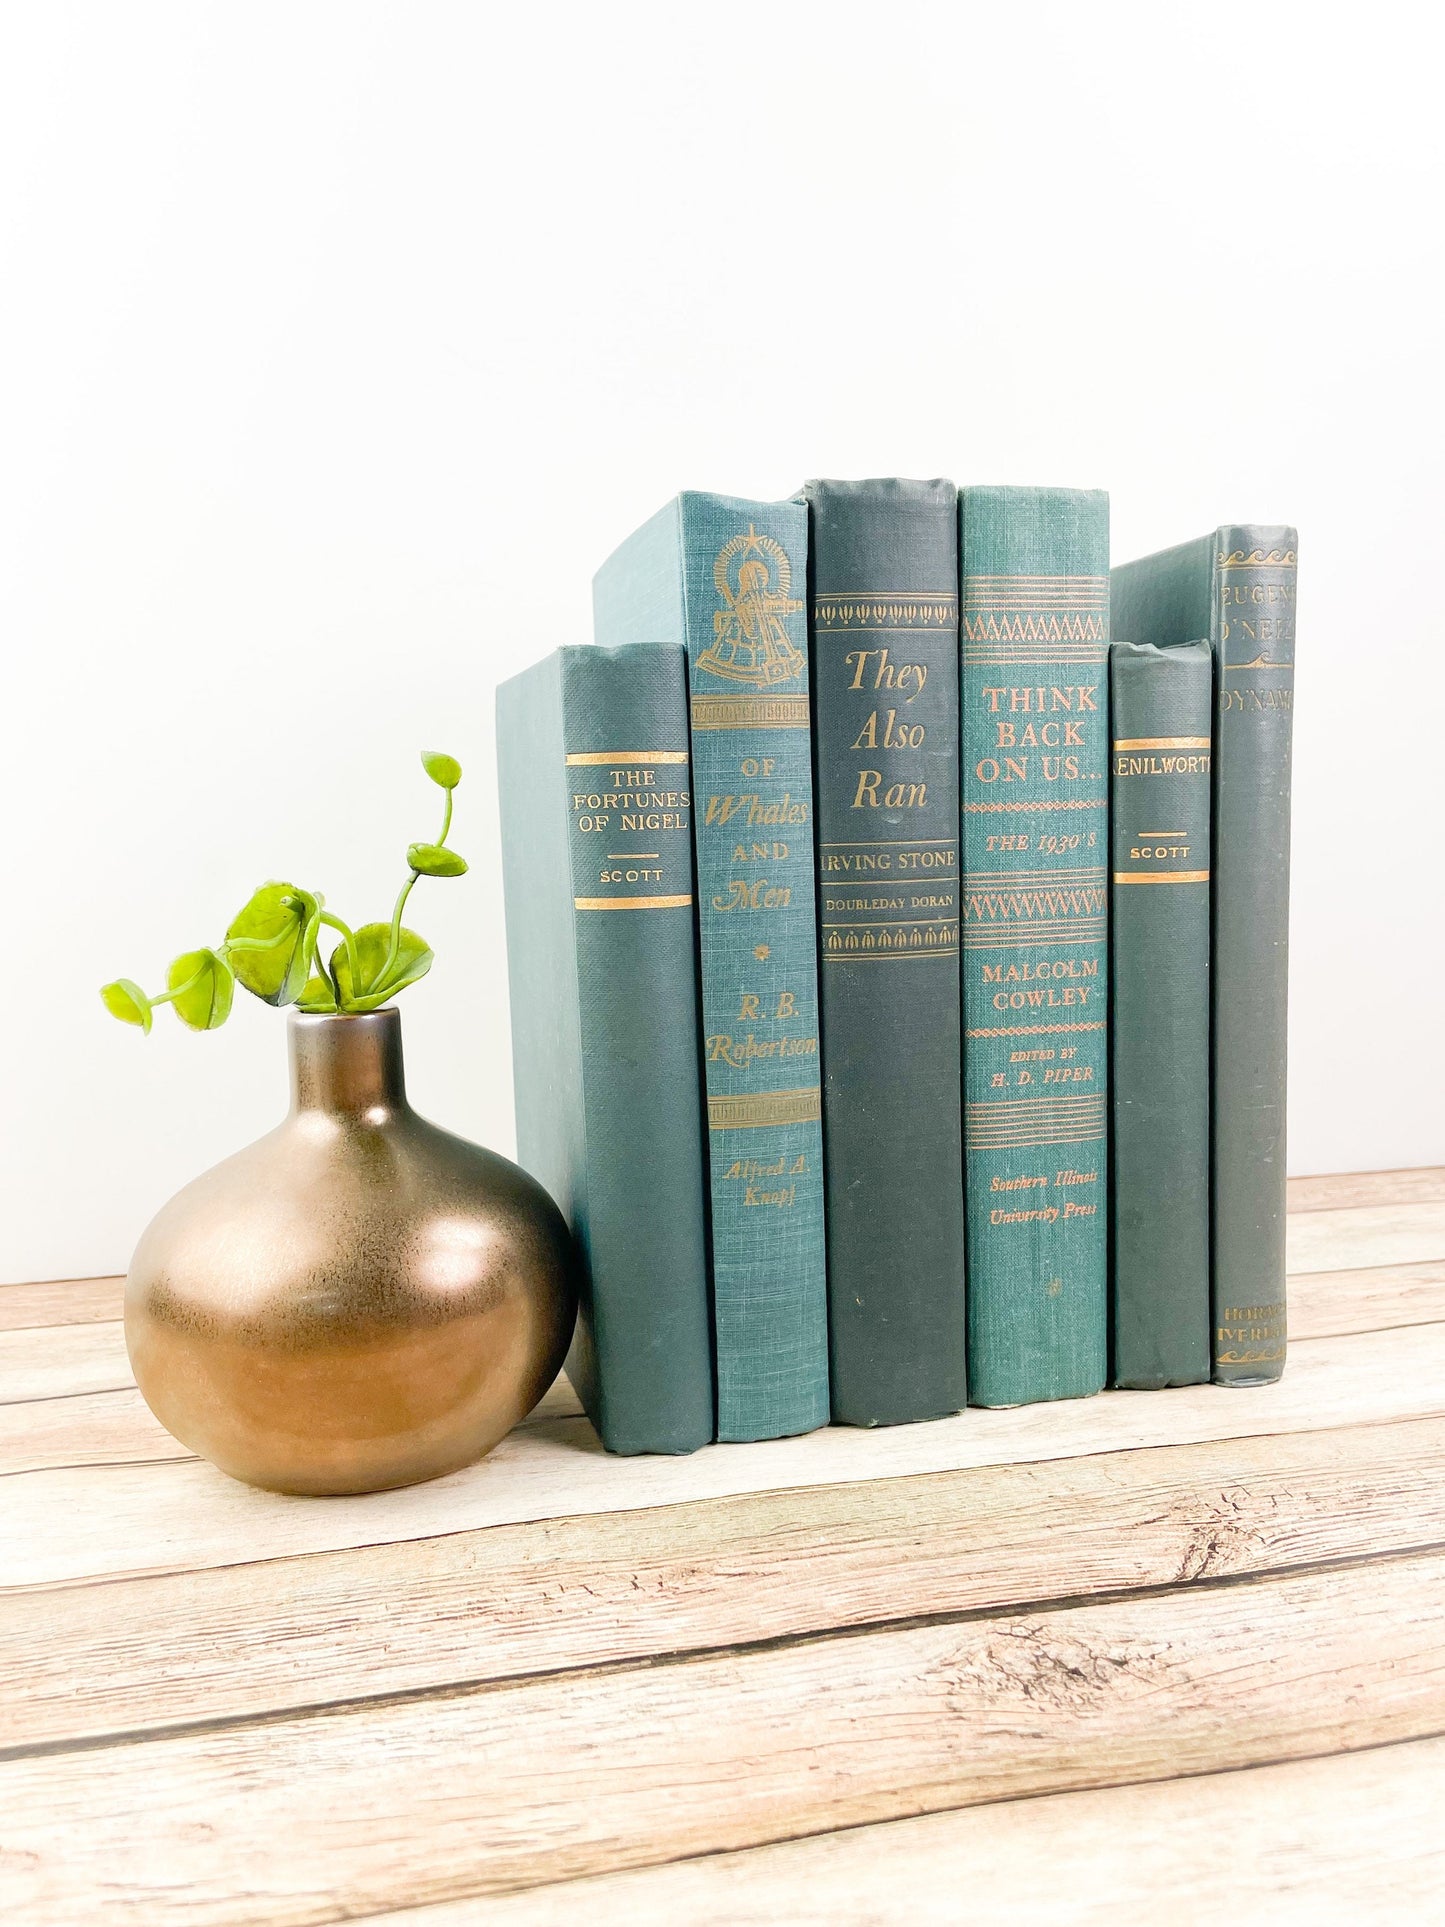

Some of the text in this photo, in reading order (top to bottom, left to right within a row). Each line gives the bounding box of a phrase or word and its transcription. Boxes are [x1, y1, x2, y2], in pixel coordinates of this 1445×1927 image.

[845, 649, 928, 703] They
[982, 686, 1099, 712] THINK
[850, 709, 926, 749] Also
[995, 721, 1086, 747] BACK
[609, 770, 656, 787] THE
[741, 758, 775, 777] OF
[976, 757, 1028, 783] ON
[572, 792, 691, 810] FORTUNES
[850, 770, 928, 809] Ran
[705, 793, 808, 826] Whales
[579, 813, 688, 832] OF NIGEL
[732, 842, 790, 862] AND
[986, 835, 1029, 851] THE
[1130, 847, 1191, 859] SCOTT
[820, 851, 956, 871] IRVING STONE
[600, 869, 663, 883] SCOTT
[712, 879, 792, 911] Men
[826, 895, 953, 910] DOUBLEDAY DORAN
[982, 959, 1099, 984] MALCOLM
[737, 991, 800, 1020] R. B.
[992, 987, 1091, 1010] COWLEY
[706, 1034, 817, 1069] Robertson
[1009, 1047, 1078, 1062] EDITED BY
[990, 1066, 1094, 1088] H. D. PIPER
[722, 1154, 811, 1183] Alfred A.
[989, 1169, 1098, 1192] Southern Illinois
[742, 1183, 796, 1208] Knopf
[989, 1202, 1097, 1225] University Press
